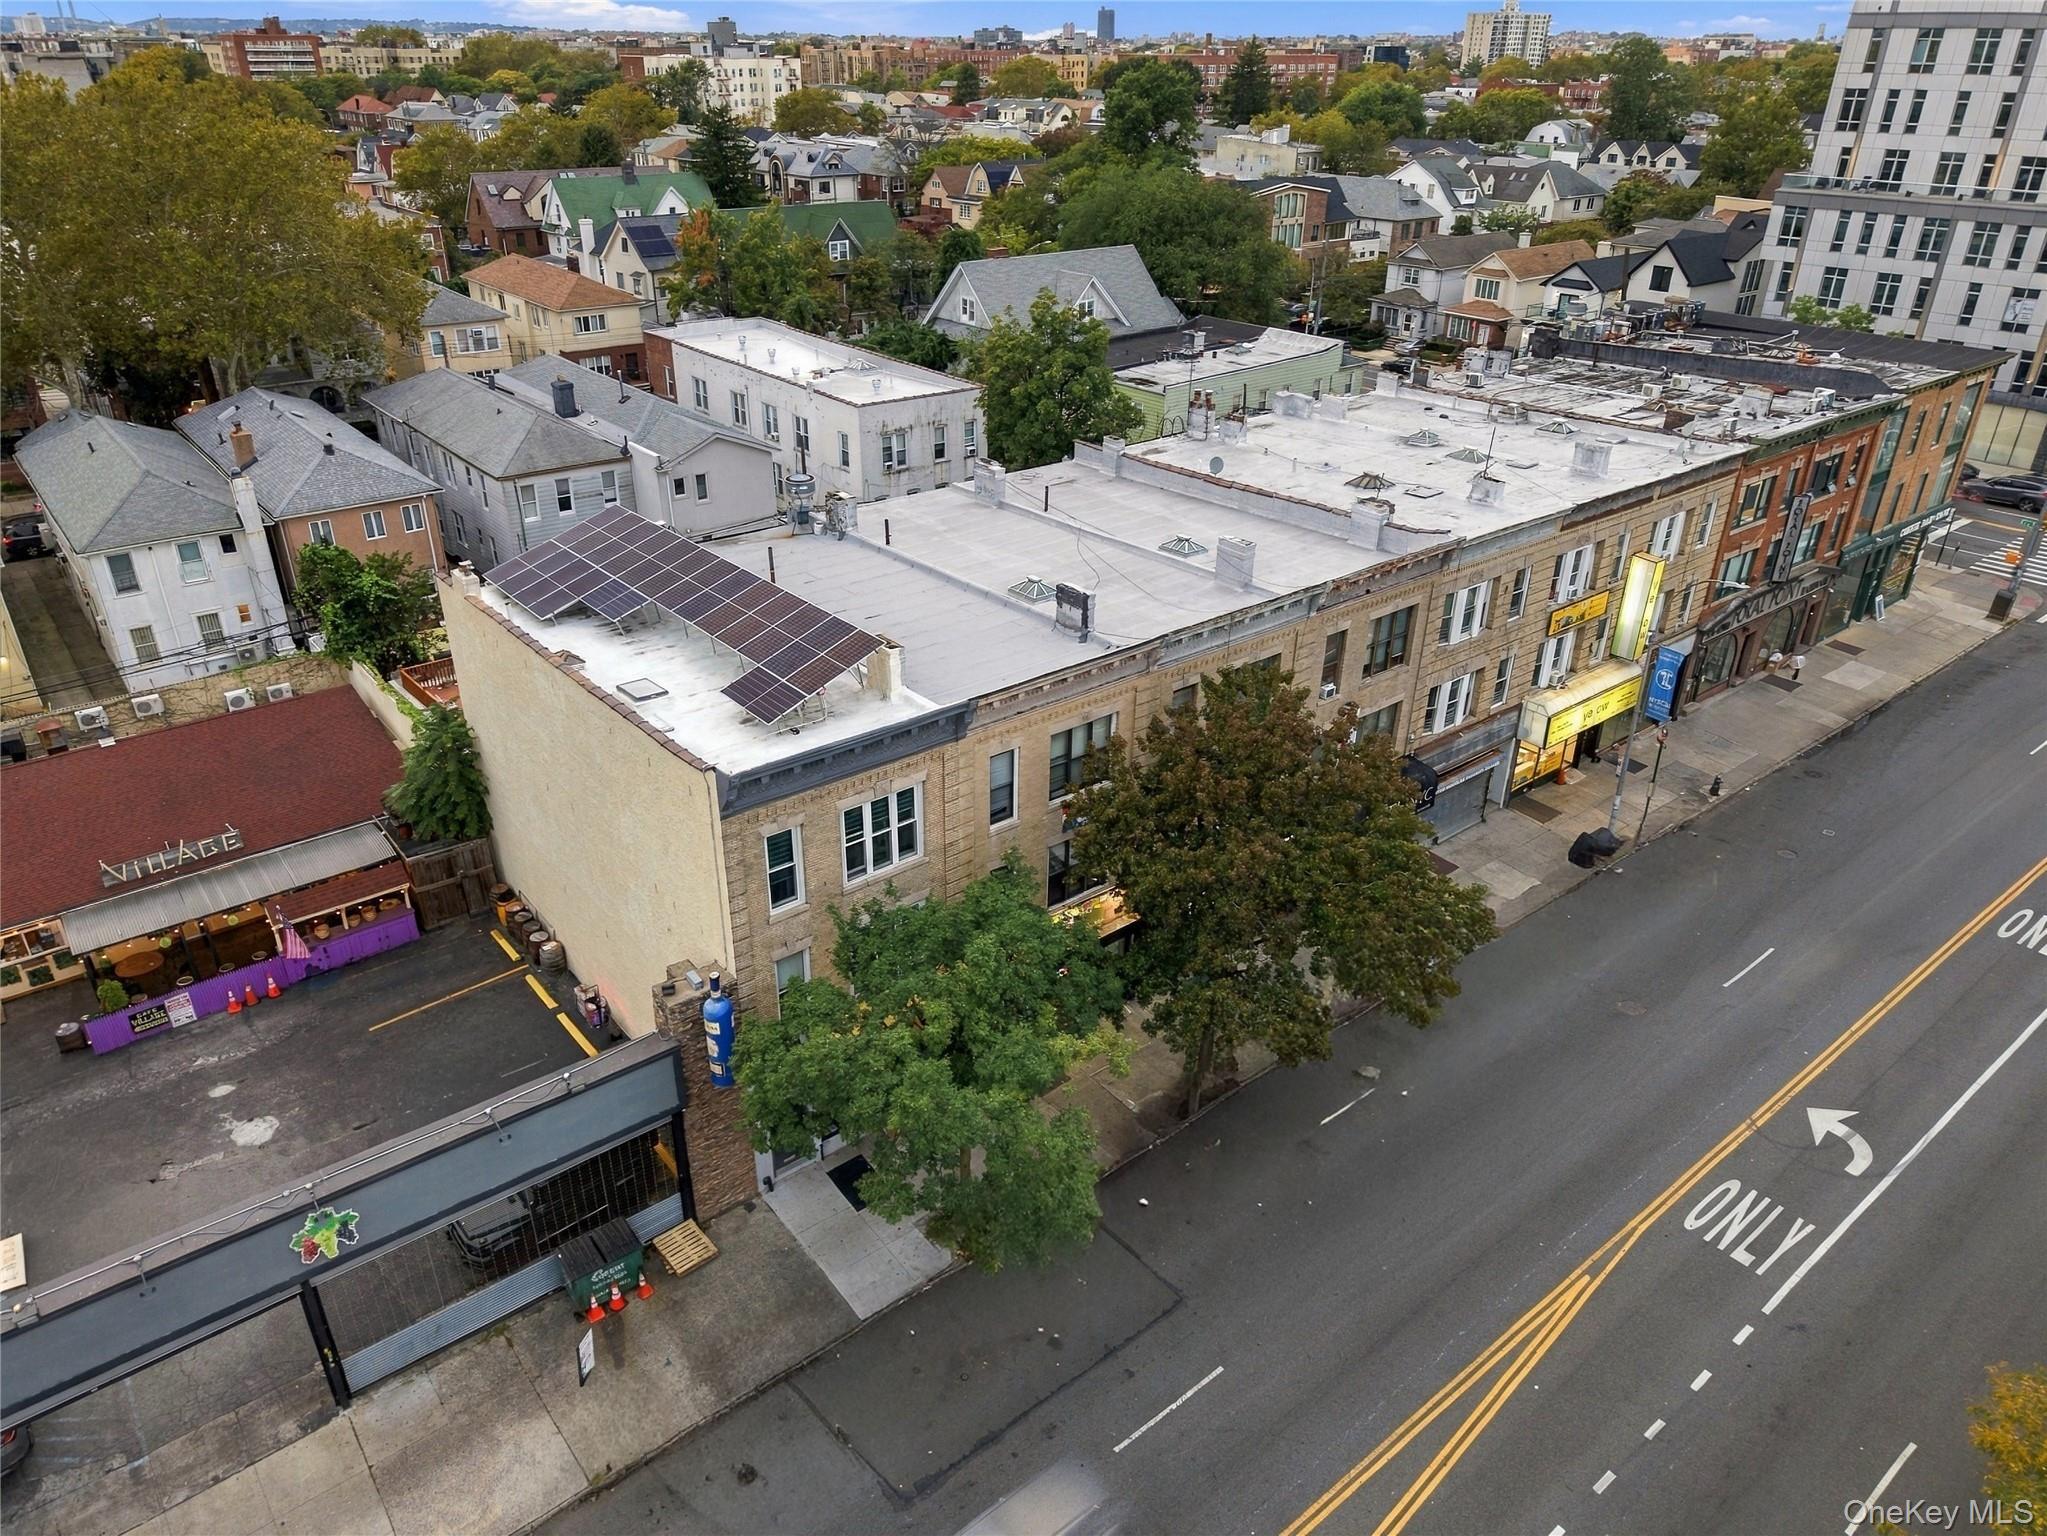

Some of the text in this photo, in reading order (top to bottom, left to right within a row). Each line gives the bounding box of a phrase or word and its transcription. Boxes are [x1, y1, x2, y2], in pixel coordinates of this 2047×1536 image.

[98, 831, 242, 882] VILLAGE
[1996, 908, 2047, 957] ON
[130, 1009, 167, 1027] VILLAGE
[135, 1007, 158, 1019] CAFE
[1683, 1179, 1816, 1276] ONLY
